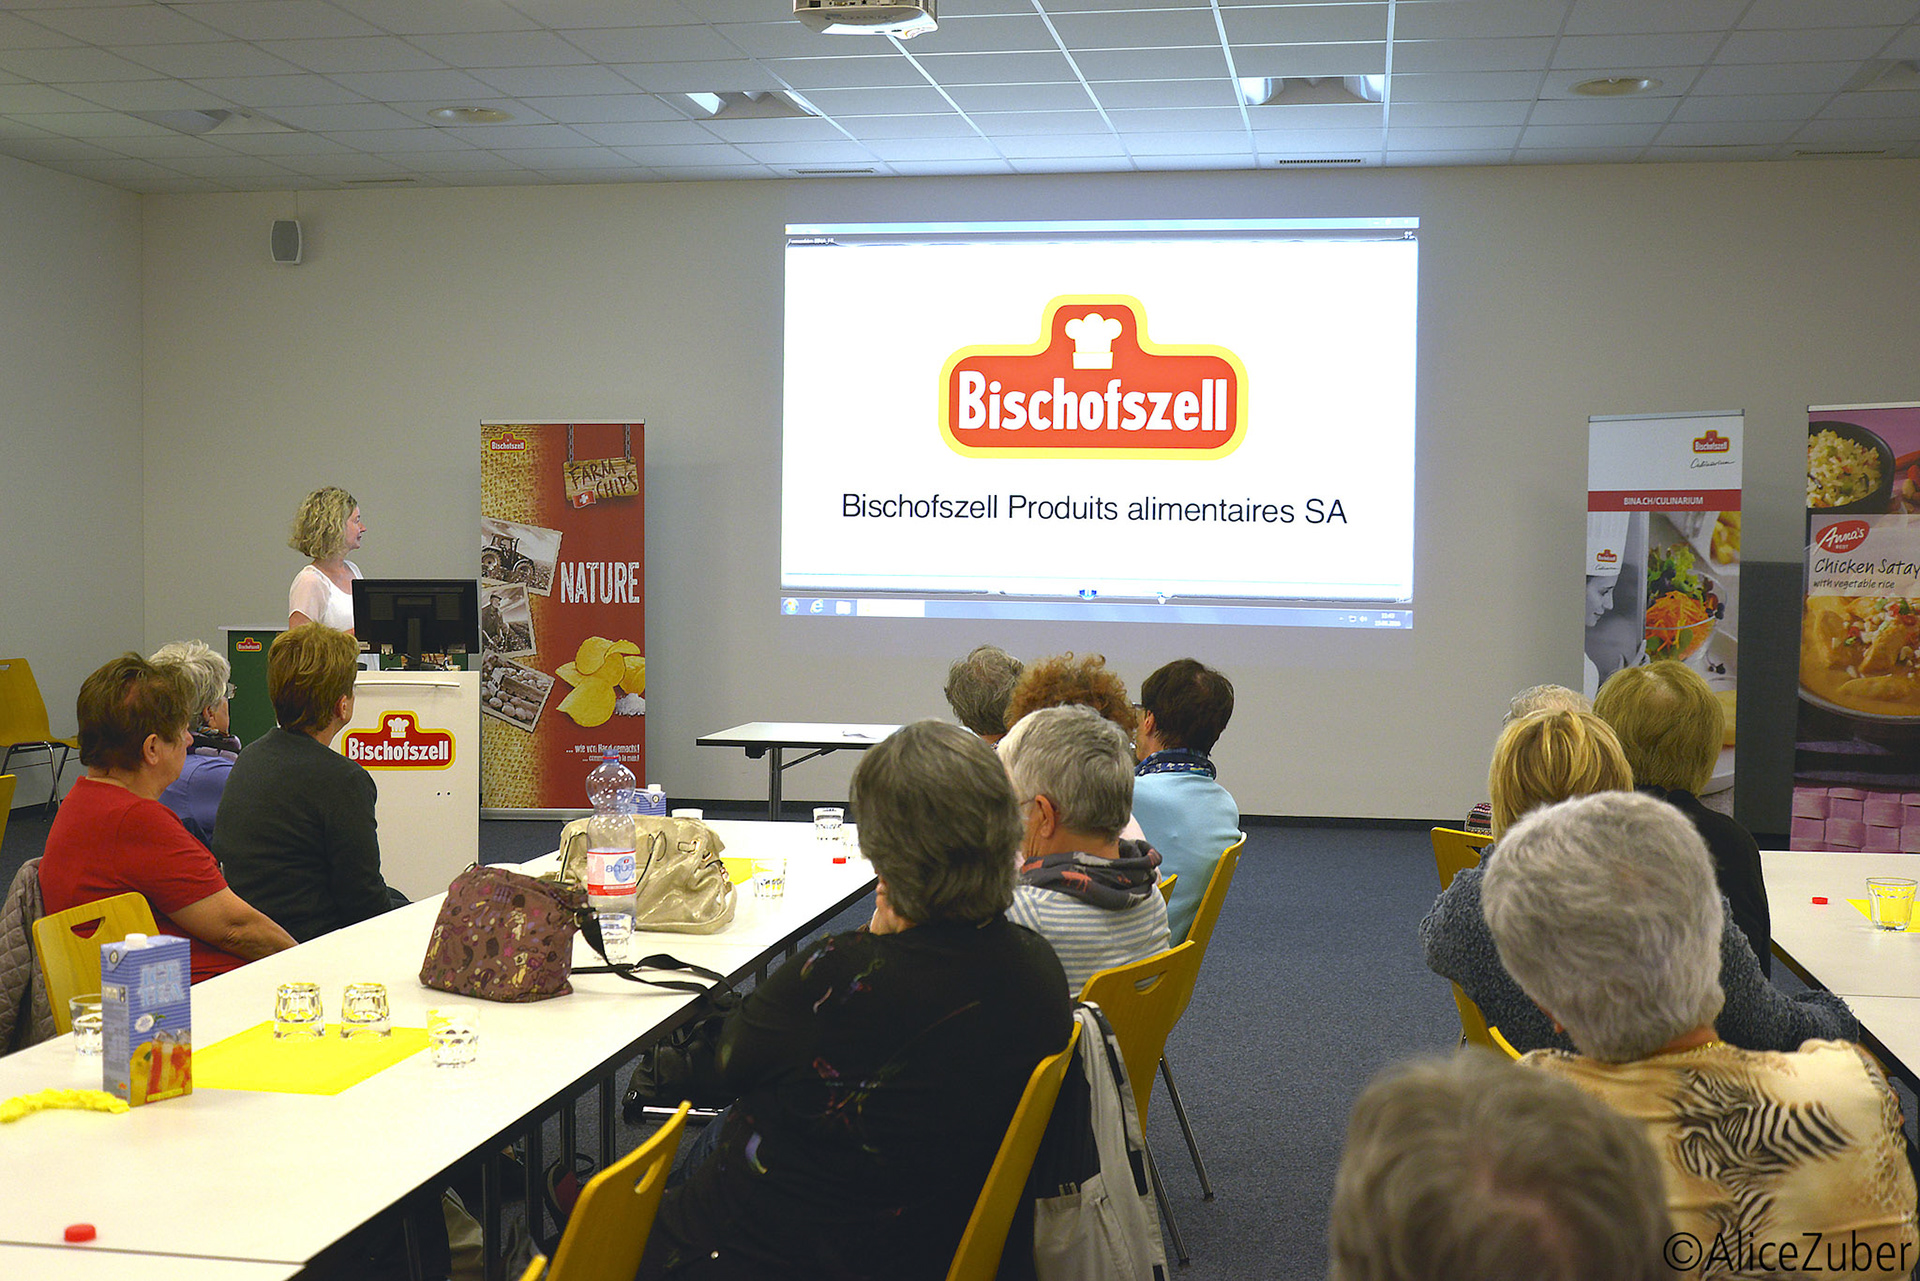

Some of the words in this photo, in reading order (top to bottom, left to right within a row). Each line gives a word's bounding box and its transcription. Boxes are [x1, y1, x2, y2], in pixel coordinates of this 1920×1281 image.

[958, 370, 1227, 431] Bischofszell
[491, 441, 525, 450] Bischofszell
[568, 460, 617, 489] FARM
[595, 471, 638, 498] CHIPS
[842, 493, 998, 520] Bischofszell
[1009, 494, 1118, 522] Produits
[1128, 496, 1295, 524] alimentaires
[1304, 498, 1348, 525] SA
[1623, 497, 1704, 506] BINA.CH/CULINARIUM
[1813, 526, 1865, 552] Anna's
[1815, 558, 1875, 575] Chicken
[1877, 558, 1920, 580] Satay
[560, 561, 640, 605] NATURE
[1813, 578, 1832, 588] with
[1834, 579, 1877, 590] vegetable
[1878, 580, 1896, 589] rice
[348, 737, 449, 761] Bischofszell
